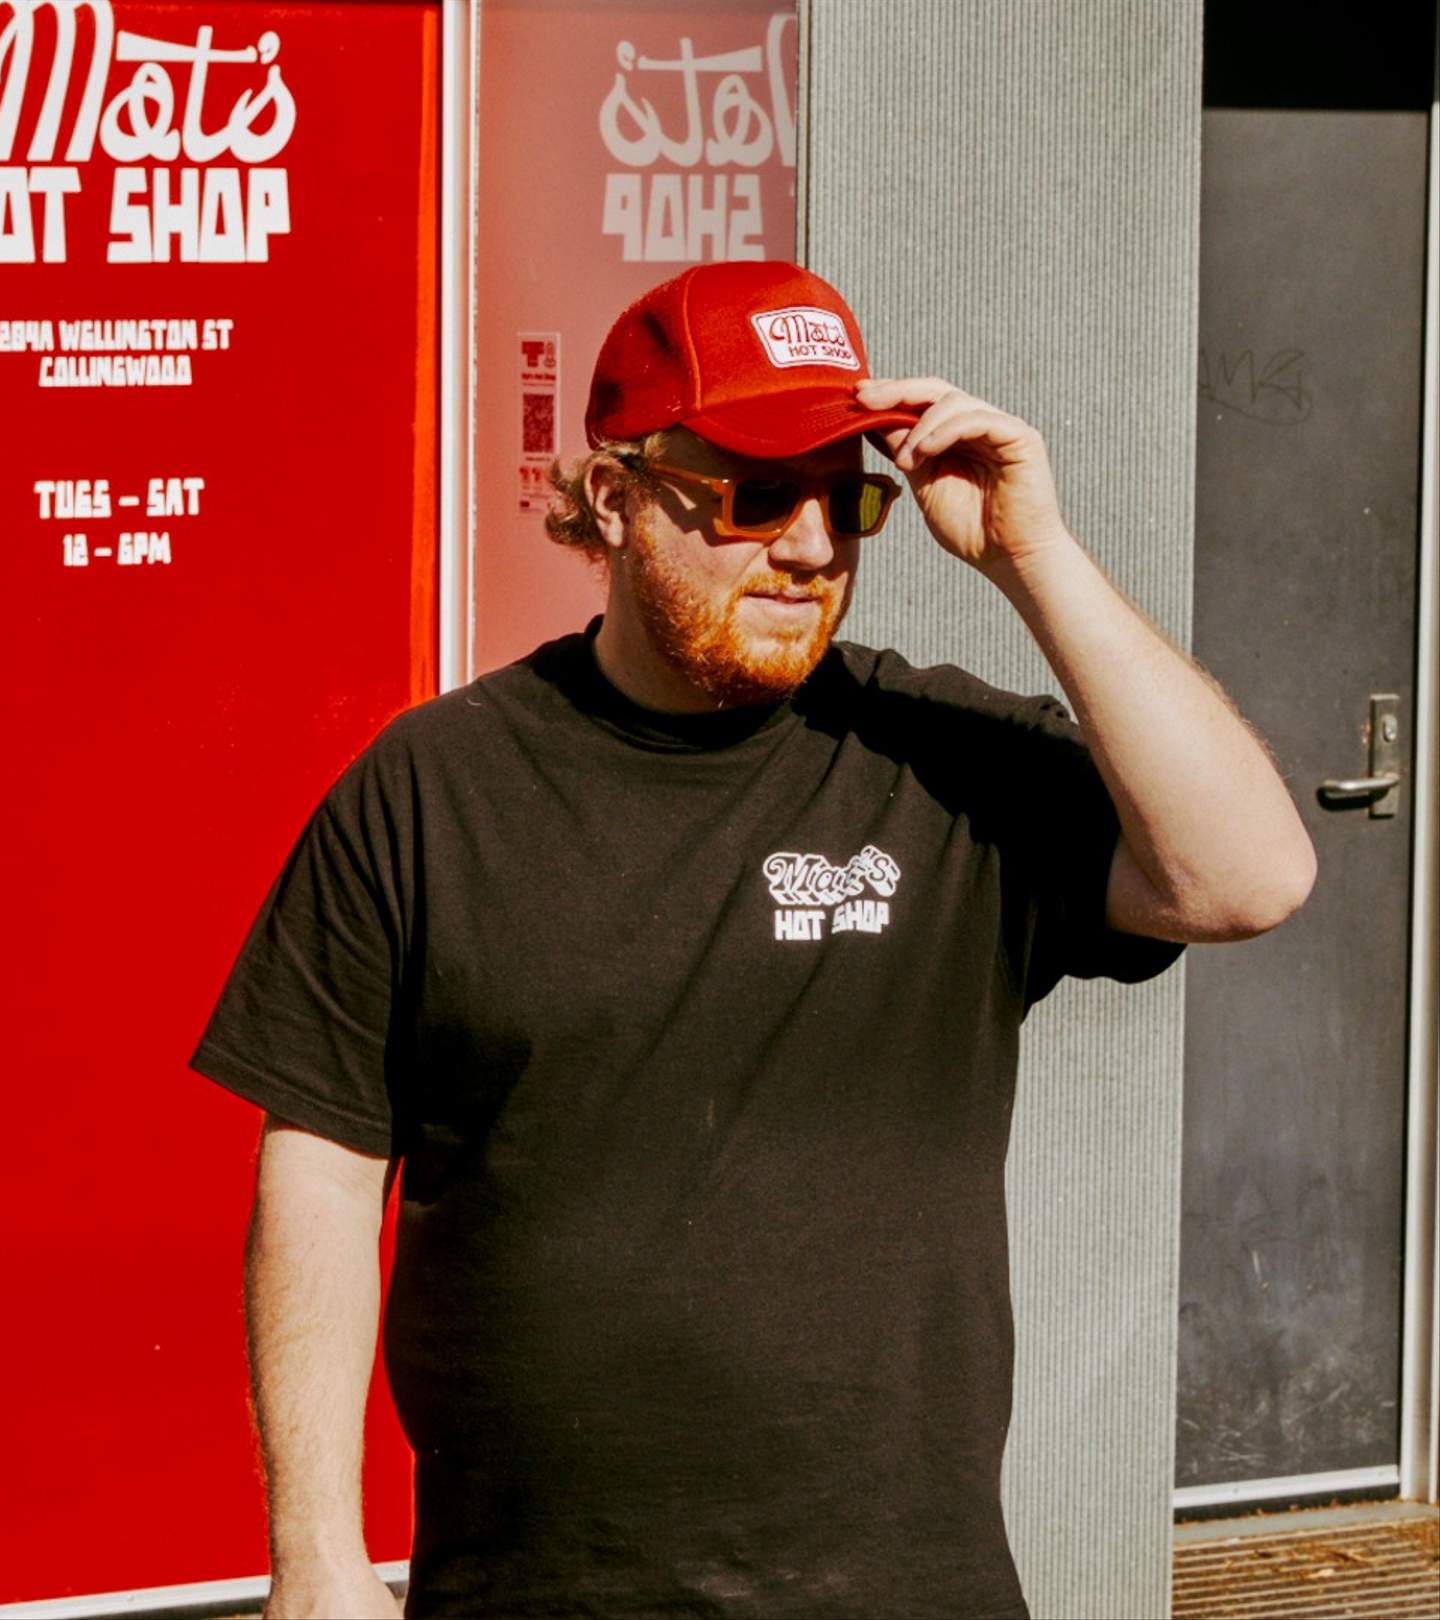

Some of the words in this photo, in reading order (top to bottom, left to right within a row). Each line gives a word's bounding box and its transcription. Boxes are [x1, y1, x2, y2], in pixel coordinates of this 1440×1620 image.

[106, 166, 291, 264] SHOP
[58, 319, 198, 351] WELLINGTON
[201, 318, 234, 350] ST
[788, 345, 818, 358] HOT
[38, 354, 193, 388] COLLINGWOOD
[33, 479, 112, 519] TUES
[146, 477, 205, 517] SAT
[63, 533, 89, 567] 12
[117, 531, 172, 566] 6PM
[774, 909, 827, 941] HOT
[831, 899, 890, 934] SHOP
